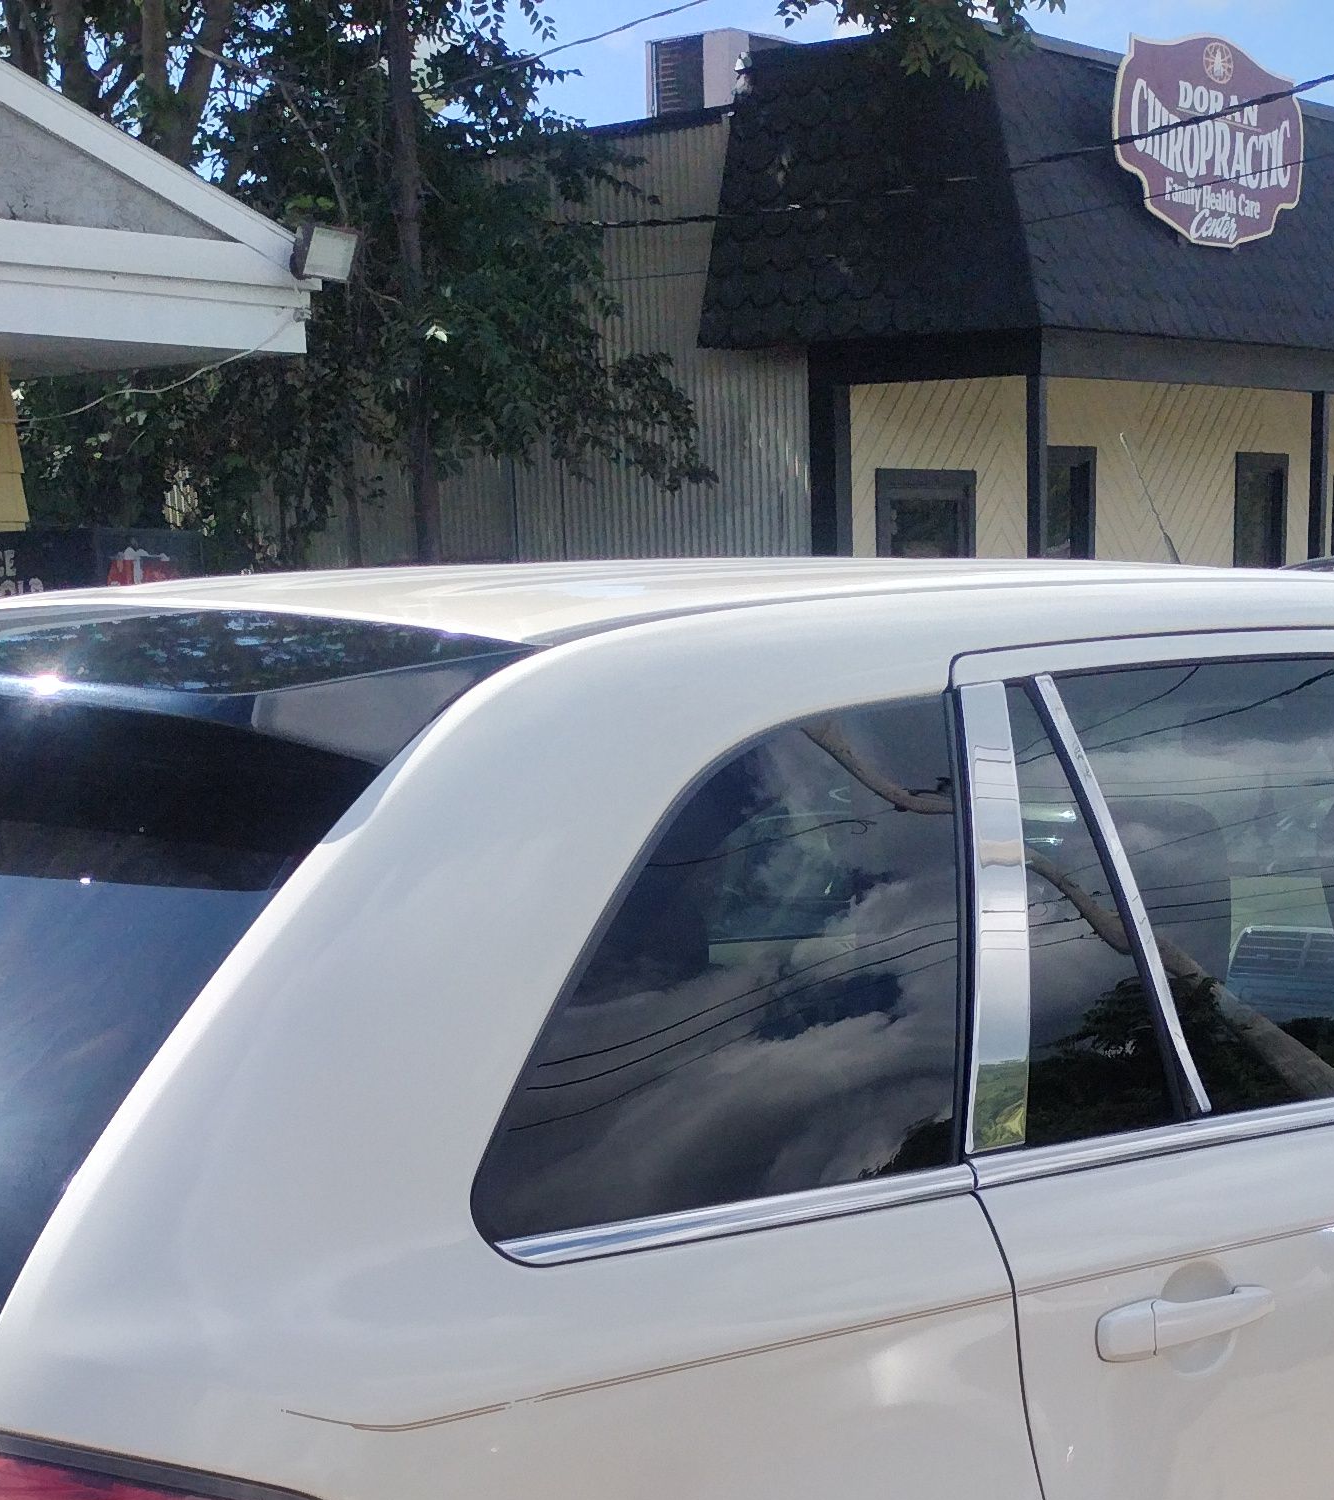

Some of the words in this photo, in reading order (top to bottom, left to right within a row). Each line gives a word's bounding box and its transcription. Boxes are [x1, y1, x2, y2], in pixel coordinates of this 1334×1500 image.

[1178, 80, 1259, 127] DORAN
[1131, 78, 1291, 190] CHIROPRACTIC
[1165, 176, 1202, 213] Family
[1202, 185, 1237, 215] Health
[1238, 193, 1261, 220] Care
[1190, 208, 1238, 243] Center
